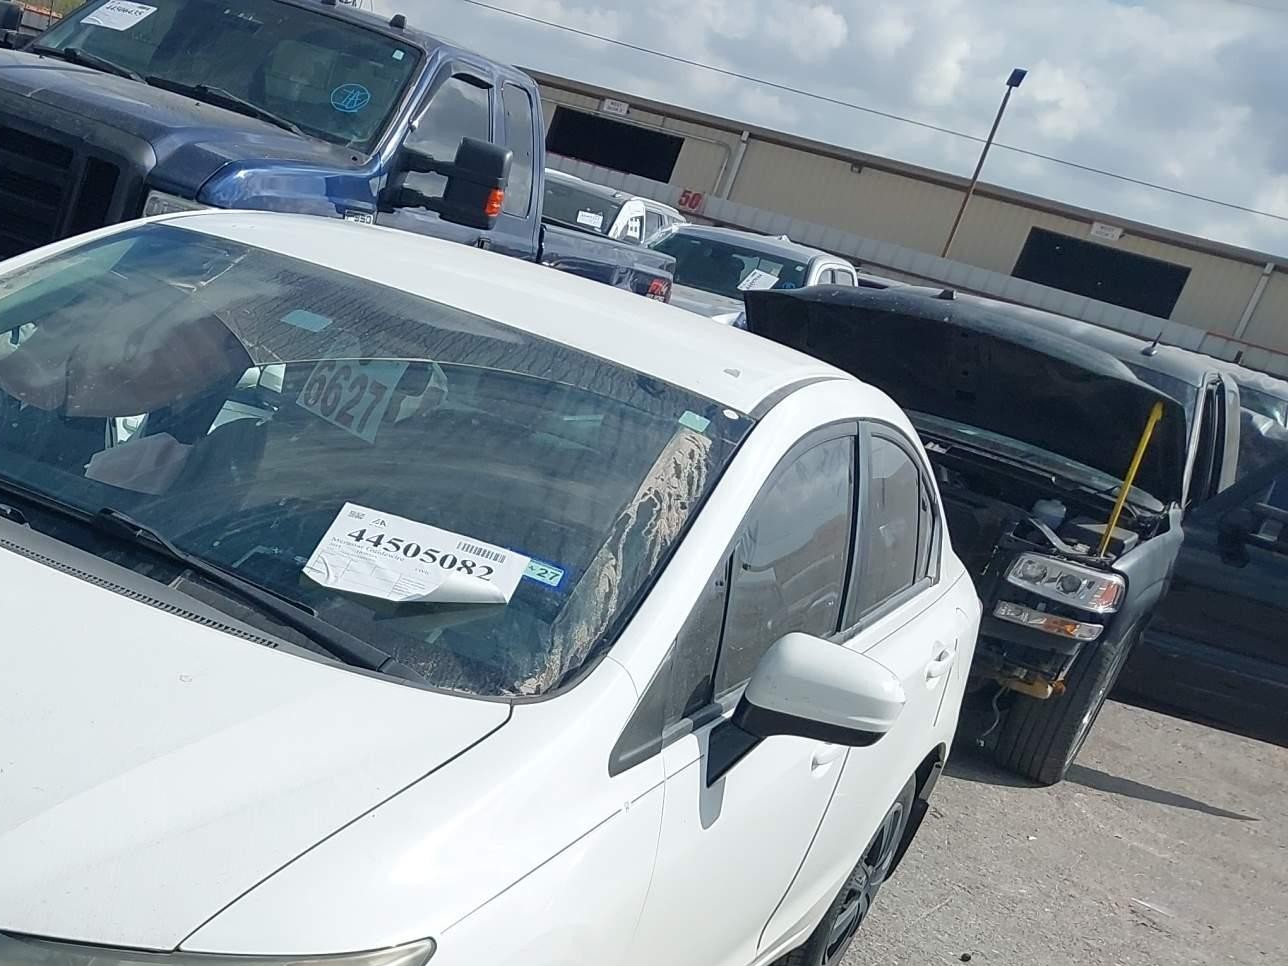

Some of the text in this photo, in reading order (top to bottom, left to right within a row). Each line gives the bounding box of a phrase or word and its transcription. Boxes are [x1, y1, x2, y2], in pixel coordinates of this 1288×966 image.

[678, 189, 702, 210] 50
[303, 360, 388, 434] 6627
[346, 528, 495, 582] 44505082
[535, 567, 561, 581] 27
